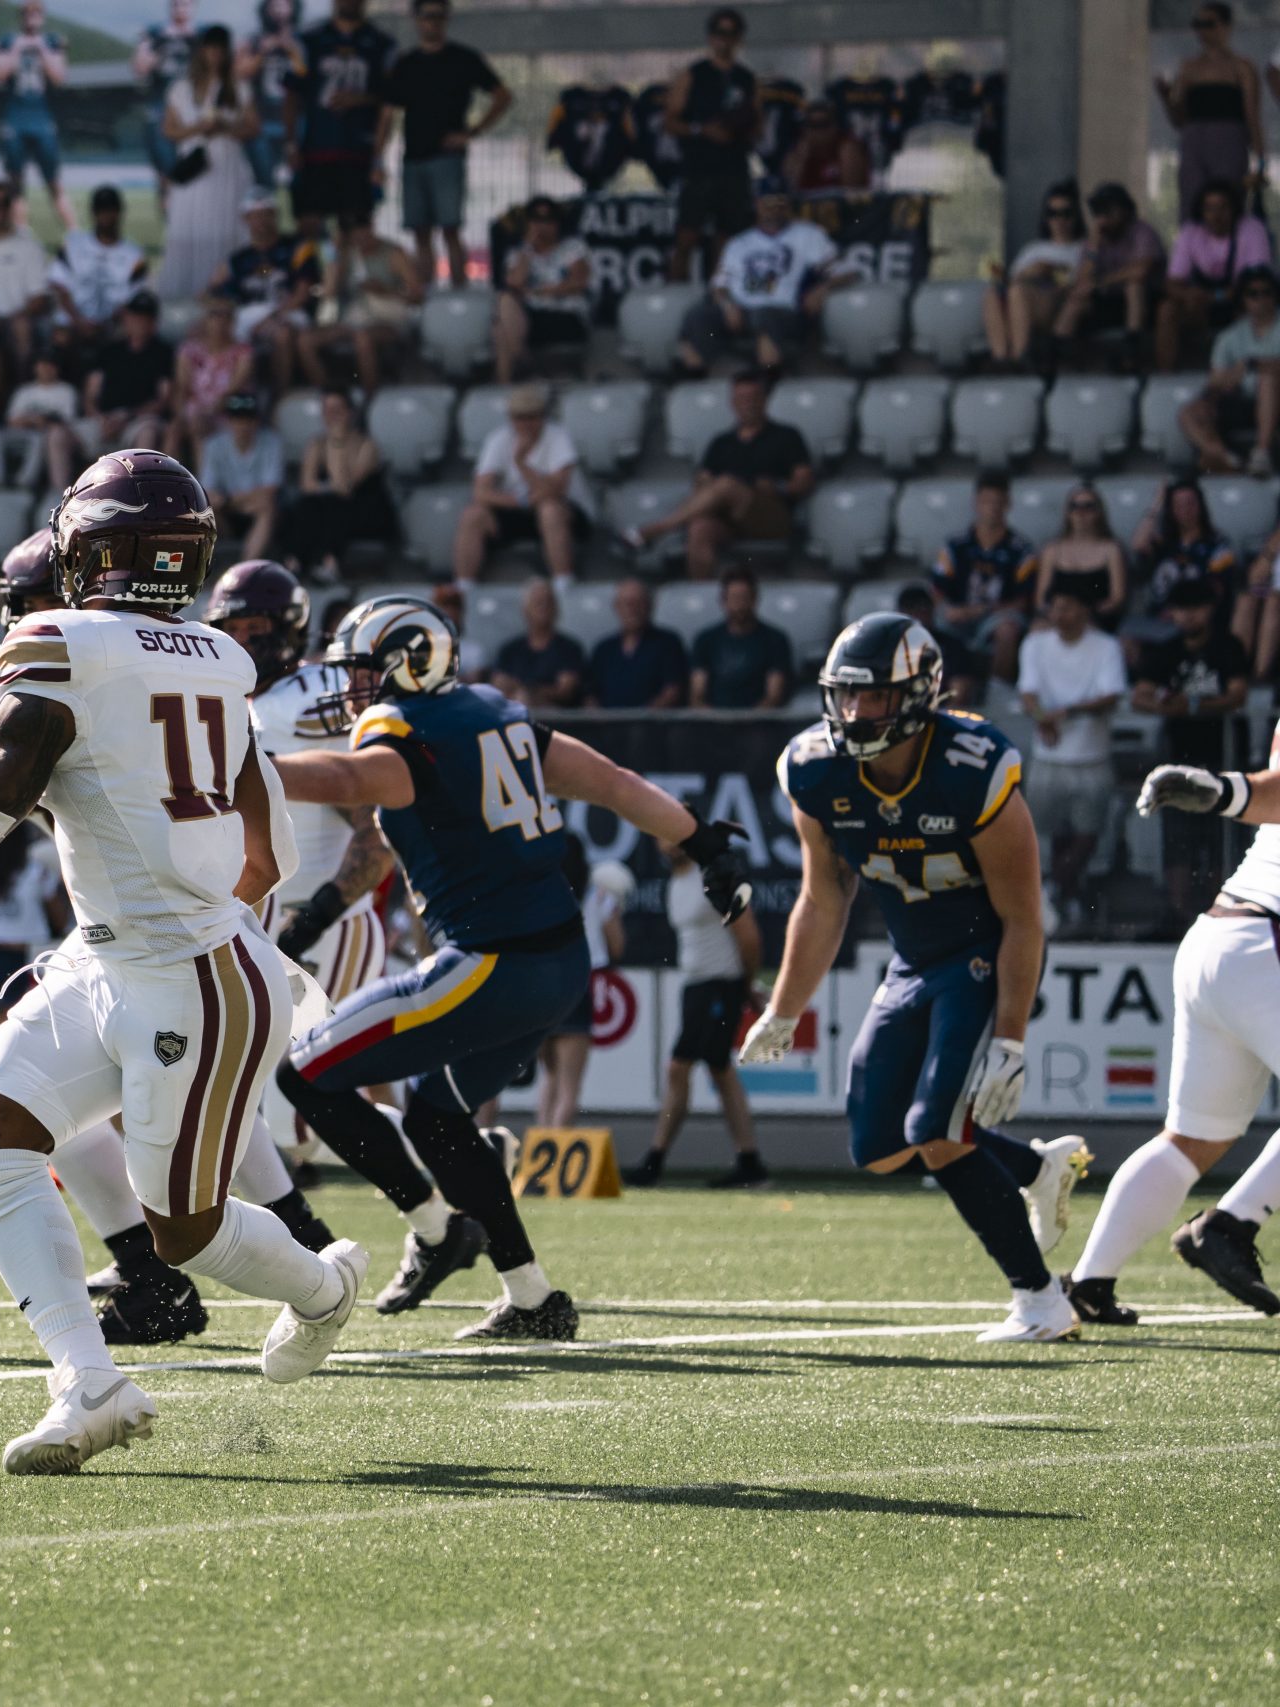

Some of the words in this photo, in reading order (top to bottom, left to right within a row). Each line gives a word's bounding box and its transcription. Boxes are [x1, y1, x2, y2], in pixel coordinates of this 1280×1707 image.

[131, 582, 189, 594] FORELLE
[135, 629, 220, 660] SCOTT
[149, 692, 238, 823] 11
[945, 732, 997, 770] 14
[476, 721, 564, 842] 42
[878, 838, 926, 850] RAMS
[522, 1138, 592, 1198] 20
